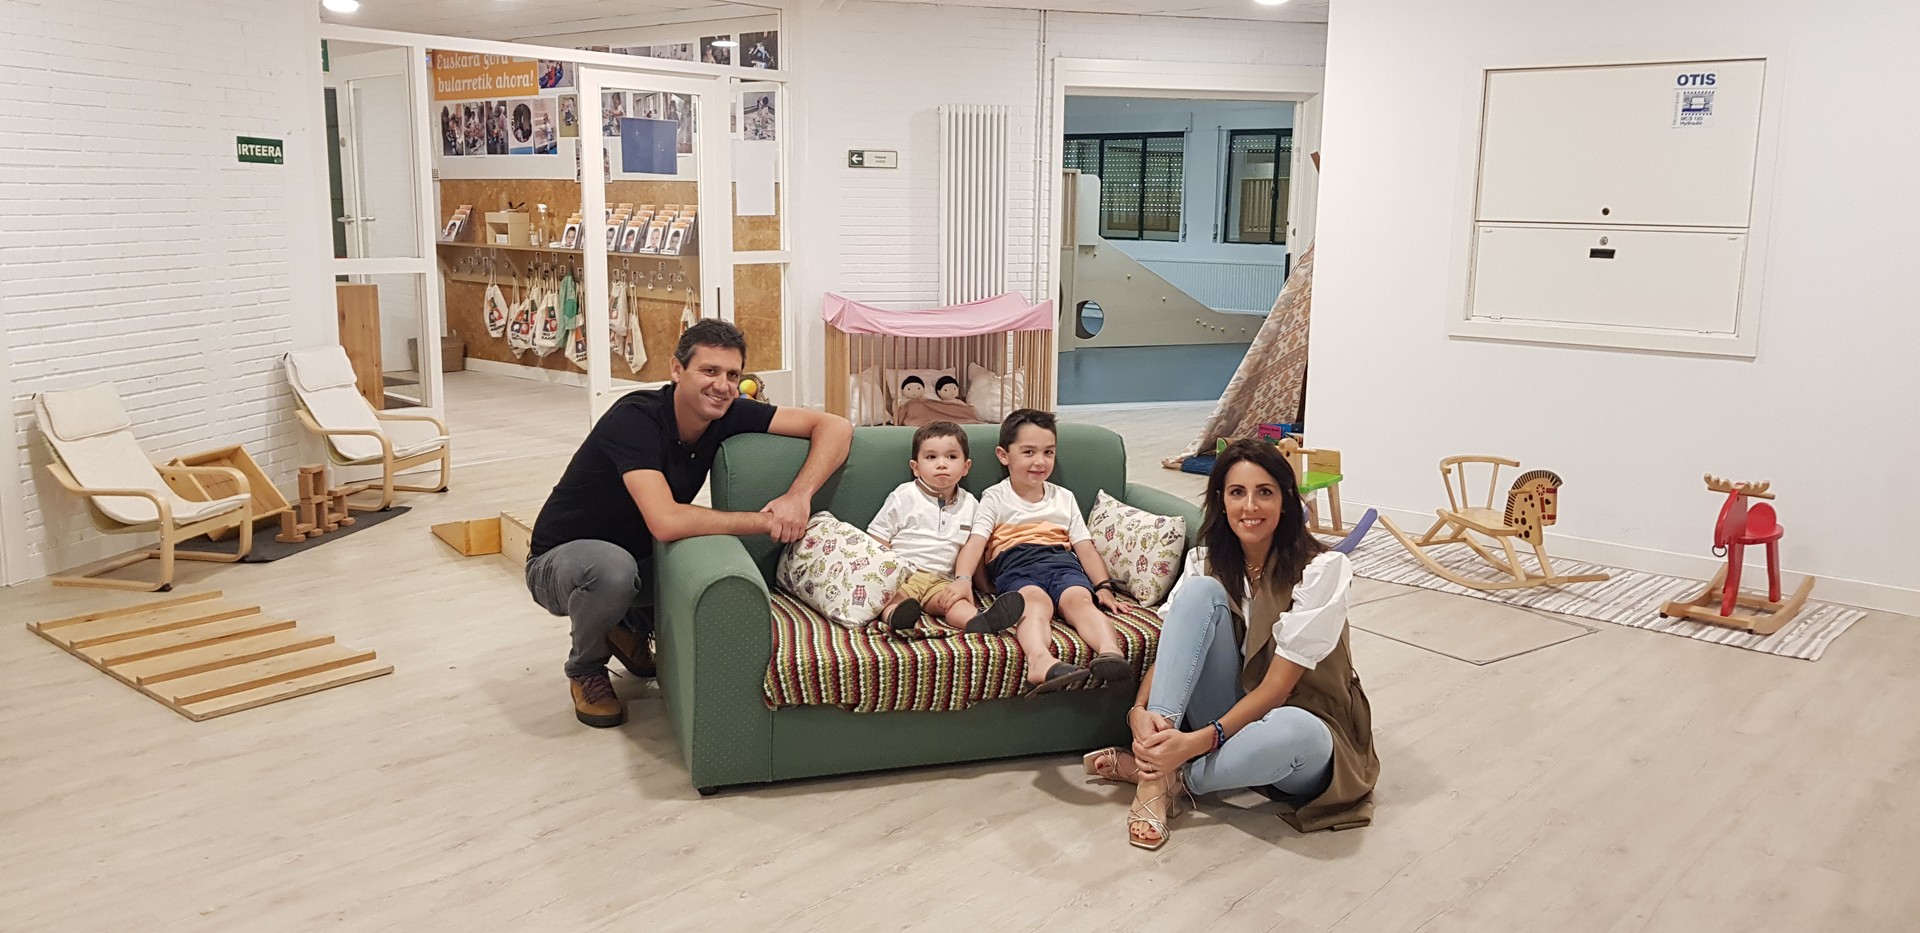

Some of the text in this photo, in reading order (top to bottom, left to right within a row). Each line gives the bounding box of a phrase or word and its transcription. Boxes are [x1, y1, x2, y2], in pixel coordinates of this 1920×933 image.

[437, 53, 480, 69] Euskara
[438, 70, 534, 92] bularretik ahora!
[1676, 73, 1716, 86] OTIS
[238, 143, 282, 157] IRTEERA
